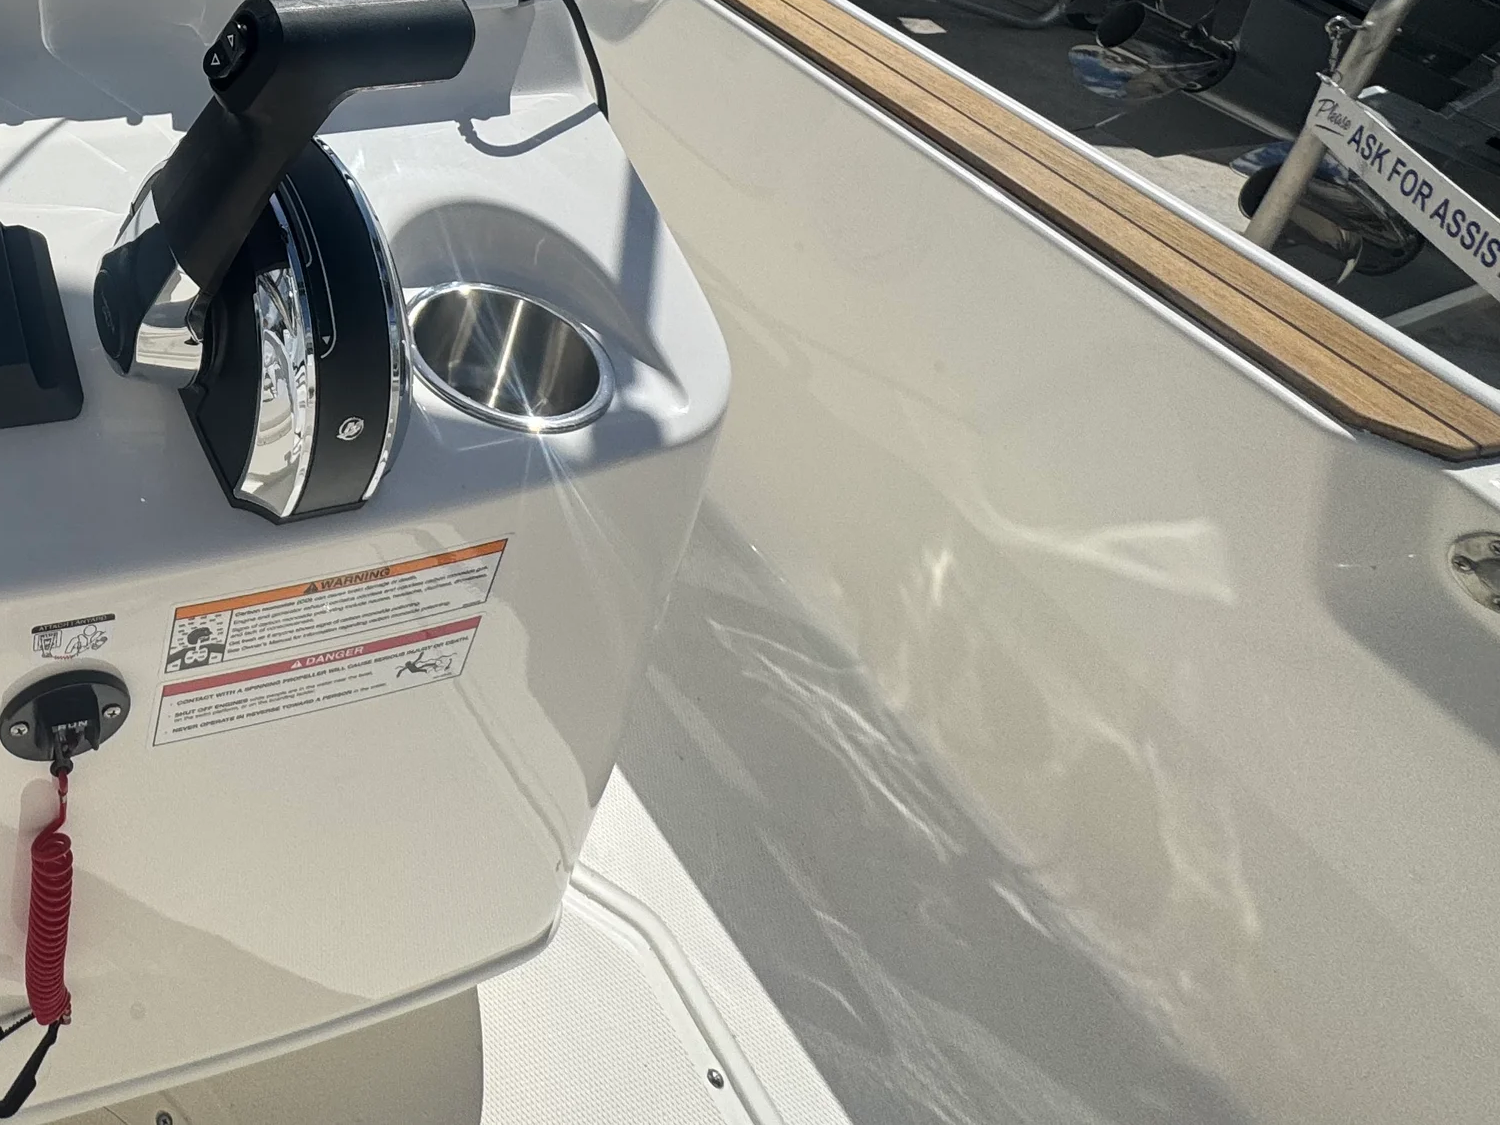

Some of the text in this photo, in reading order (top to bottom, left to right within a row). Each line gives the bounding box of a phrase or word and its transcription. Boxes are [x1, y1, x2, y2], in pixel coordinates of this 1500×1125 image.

[1315, 98, 1500, 279] Please ASK FOR ASSIS
[319, 567, 391, 590] WARNING
[38, 620, 70, 632] ATTACH
[304, 645, 365, 666] DANGER
[176, 693, 213, 706] CONTACT
[215, 688, 235, 698] WITH
[282, 669, 326, 684] PROPELLER
[347, 658, 372, 669] CAUSE
[172, 723, 198, 734] NEVER
[199, 715, 234, 728] OPERATE
[245, 705, 280, 718] REVERSE
[322, 689, 352, 700] PERSON
[174, 697, 248, 718] SHUT OFF ENGINES
[57, 720, 88, 731] RUN
